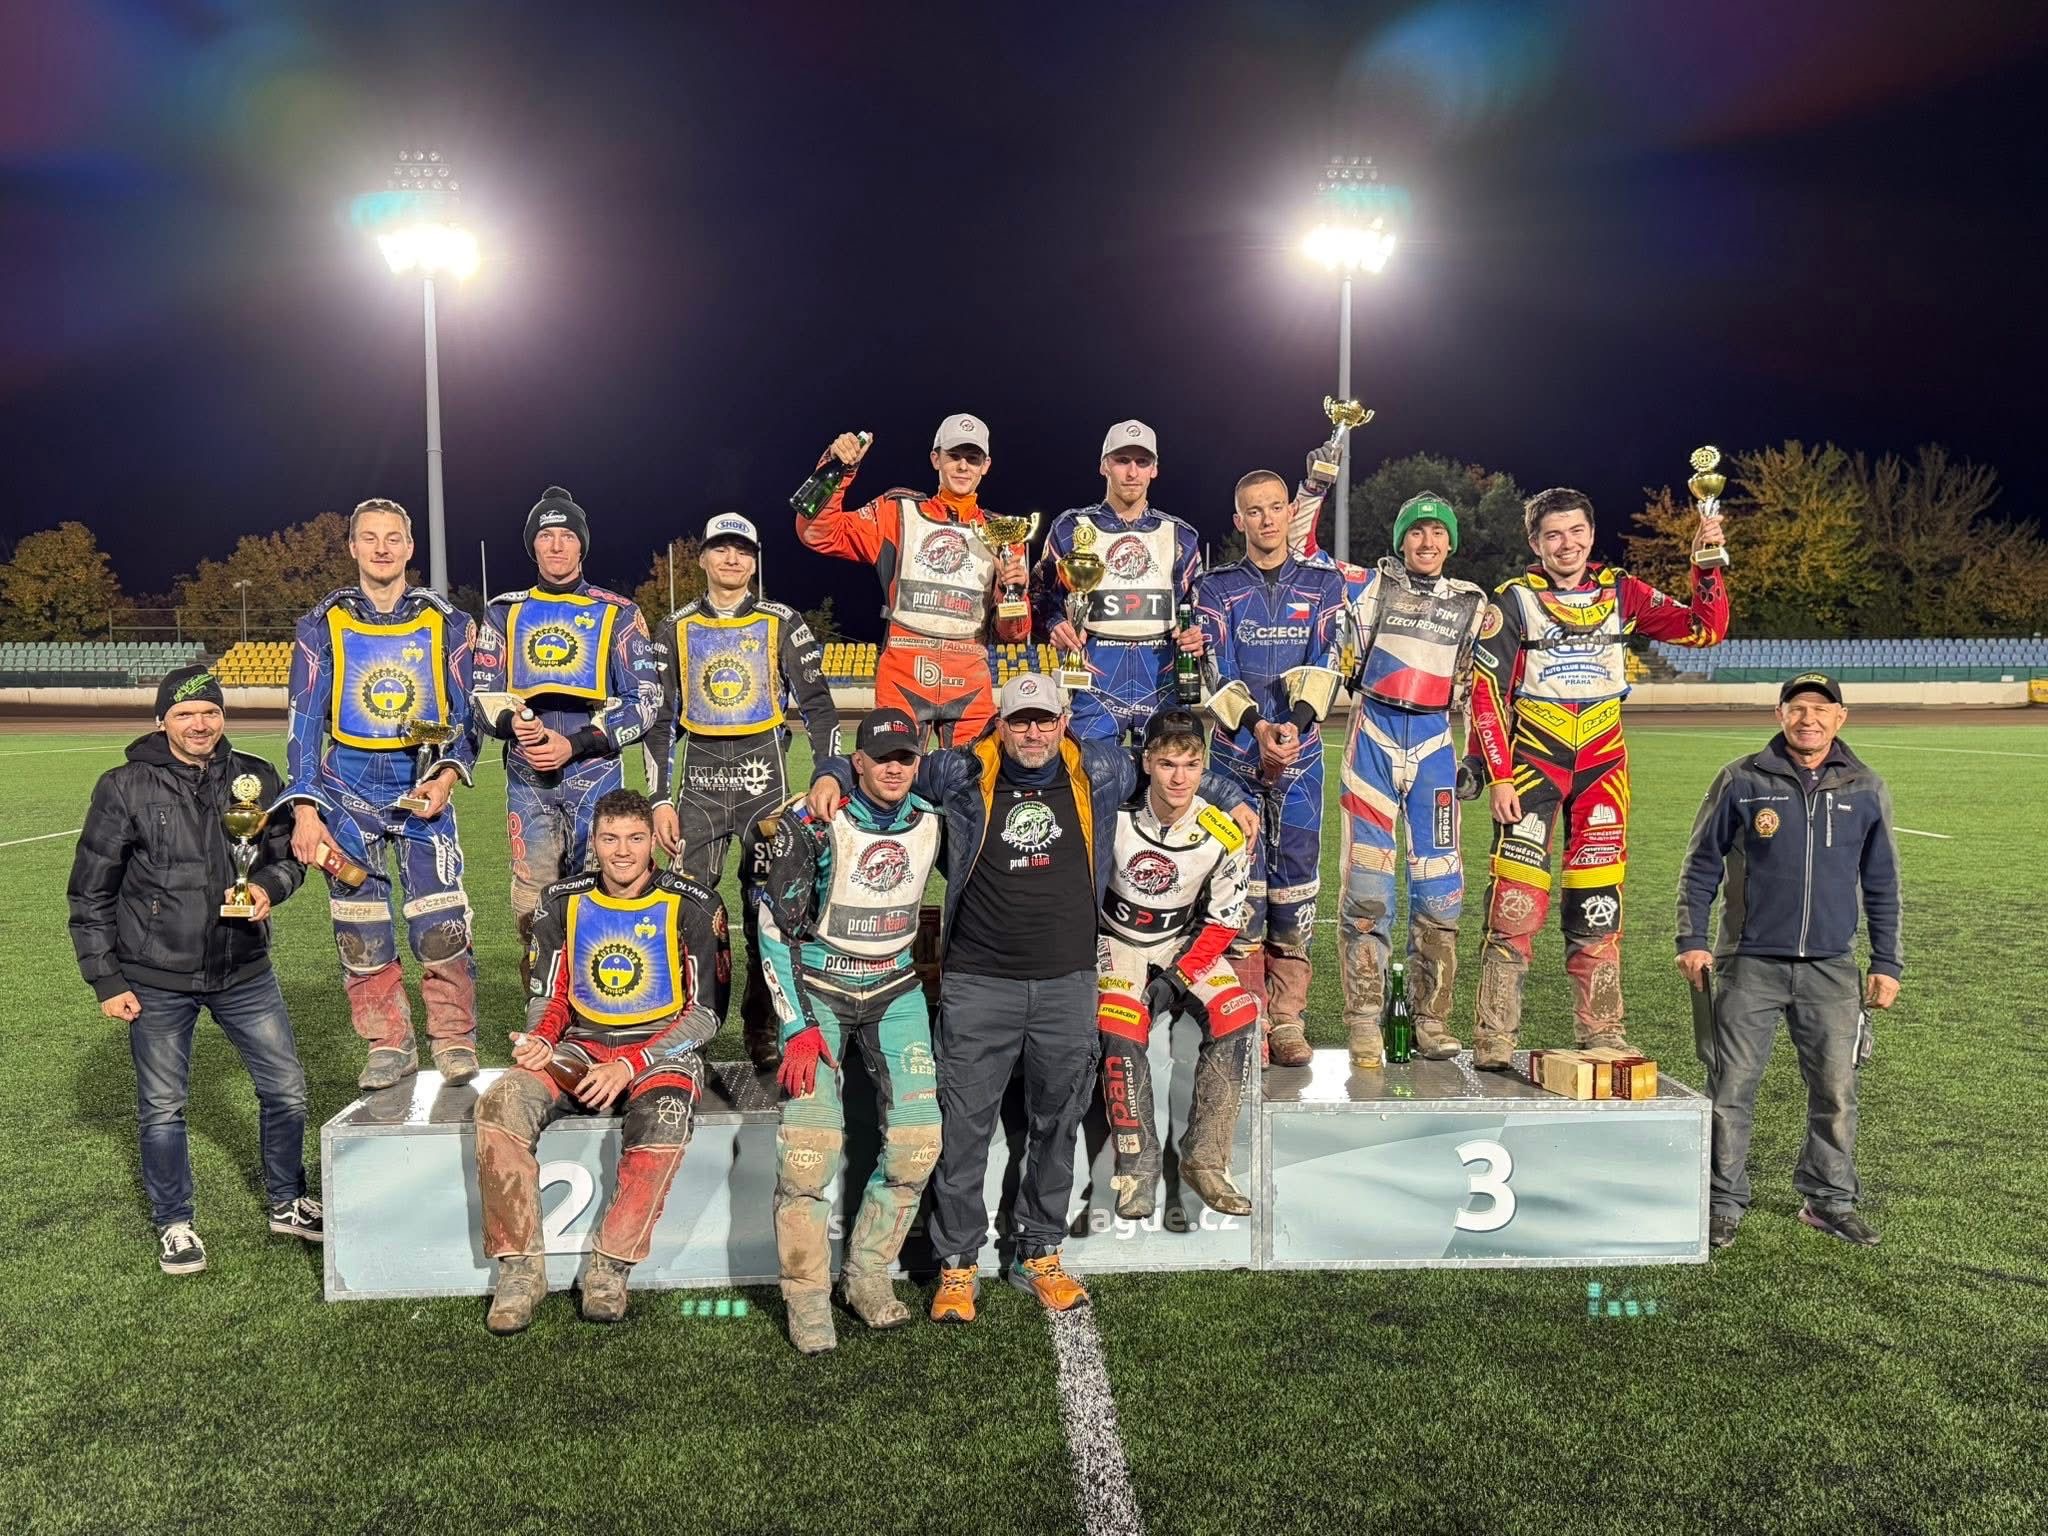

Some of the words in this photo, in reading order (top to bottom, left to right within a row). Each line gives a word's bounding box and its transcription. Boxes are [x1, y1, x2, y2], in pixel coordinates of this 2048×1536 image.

[1103, 593, 1163, 616] SPT
[1438, 608, 1459, 622] FIM
[1256, 626, 1310, 638] CZECH
[1386, 615, 1417, 628] CZECH
[1416, 619, 1459, 639] REPUBLIC
[1482, 729, 1502, 766] OLYMP
[674, 880, 710, 901] OLYMP
[1115, 902, 1178, 929] SPT
[1105, 1055, 1140, 1128] pan
[1122, 1056, 1138, 1118] materac.pl
[786, 1150, 823, 1163] FUCHS
[1454, 1138, 1517, 1233] 3
[538, 1159, 596, 1254] 2
